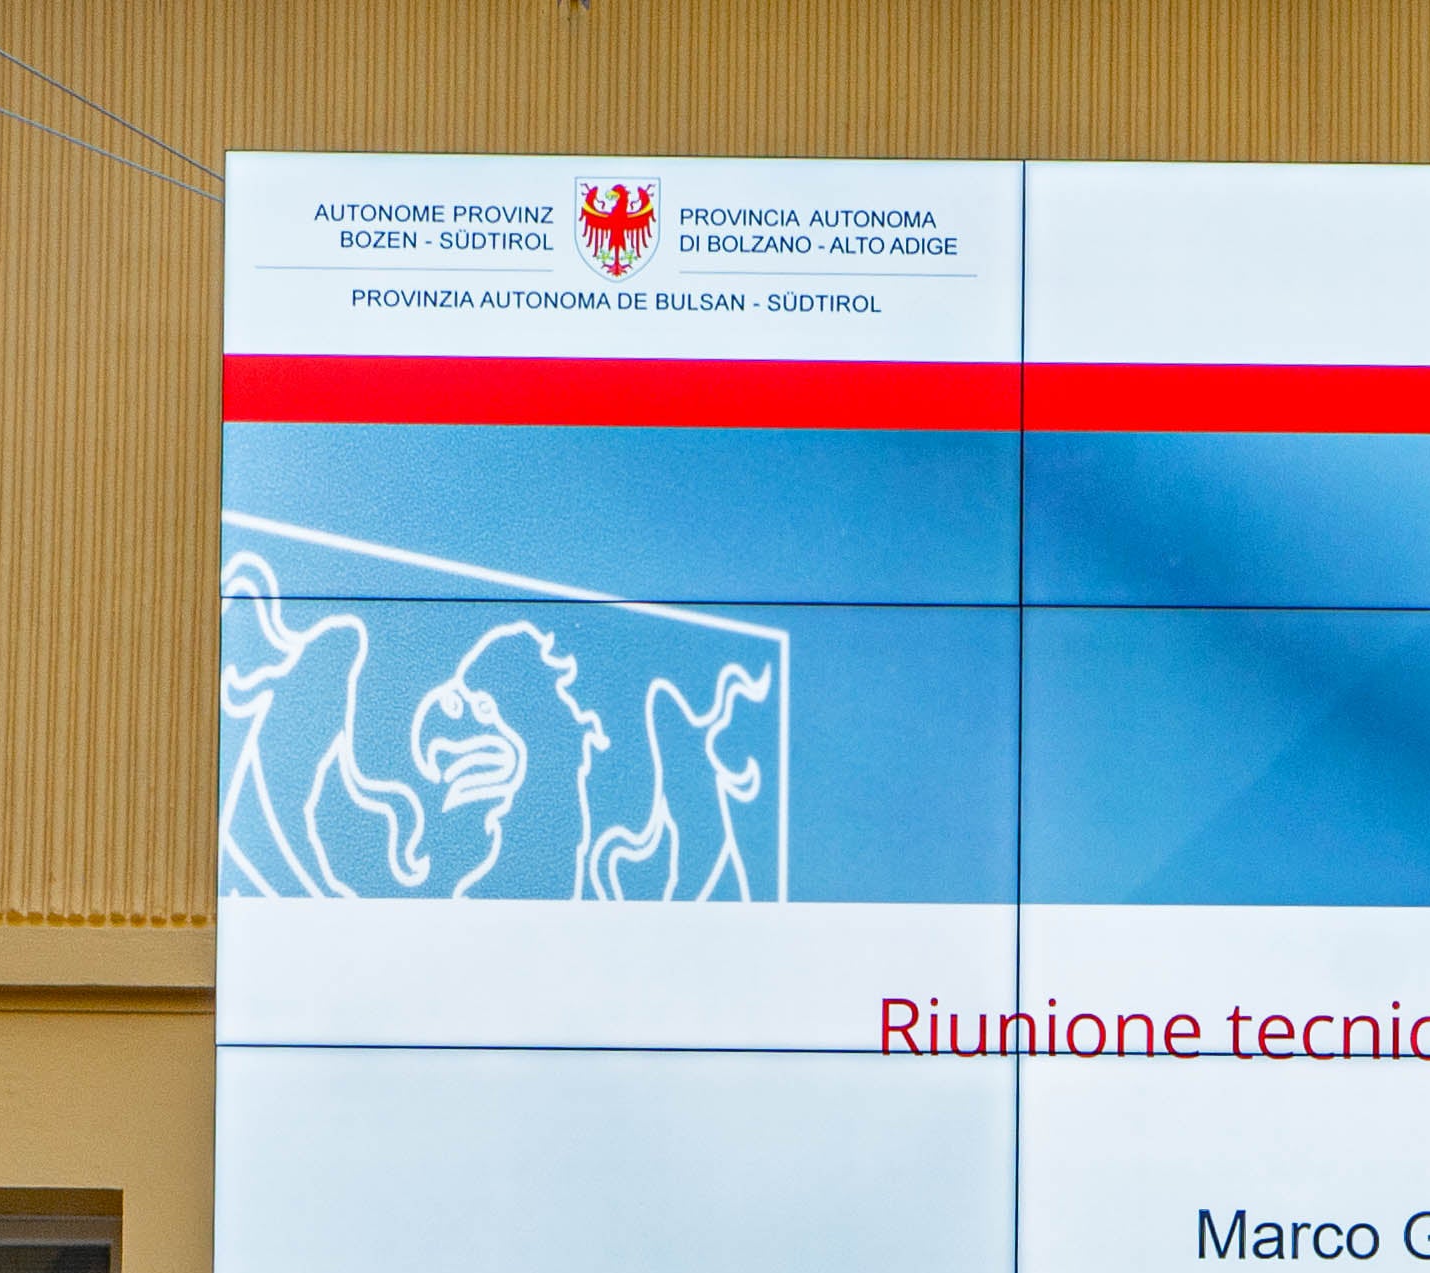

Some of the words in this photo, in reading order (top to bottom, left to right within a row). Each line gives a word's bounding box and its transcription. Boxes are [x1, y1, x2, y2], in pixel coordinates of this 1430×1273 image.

[314, 203, 445, 223] AUTONOME
[453, 205, 554, 224] PROVINZ
[680, 208, 801, 227] PROVINCIA
[809, 209, 937, 229] AUTONOMA
[340, 230, 417, 249] BOZEN
[439, 229, 554, 251] SÜDTIROL
[680, 234, 700, 253] DI
[707, 235, 812, 254] BOLZANO
[829, 236, 885, 255] ALTO
[889, 237, 958, 256] ADIGE
[352, 289, 475, 308] PROVINZIA
[479, 291, 612, 310] AUTONOMA
[617, 292, 648, 311] DE
[656, 293, 745, 312] BULSAN
[767, 291, 882, 313] SÜDTIROL
[881, 997, 1201, 1059] Riunione
[1197, 1208, 1380, 1262] Marco
